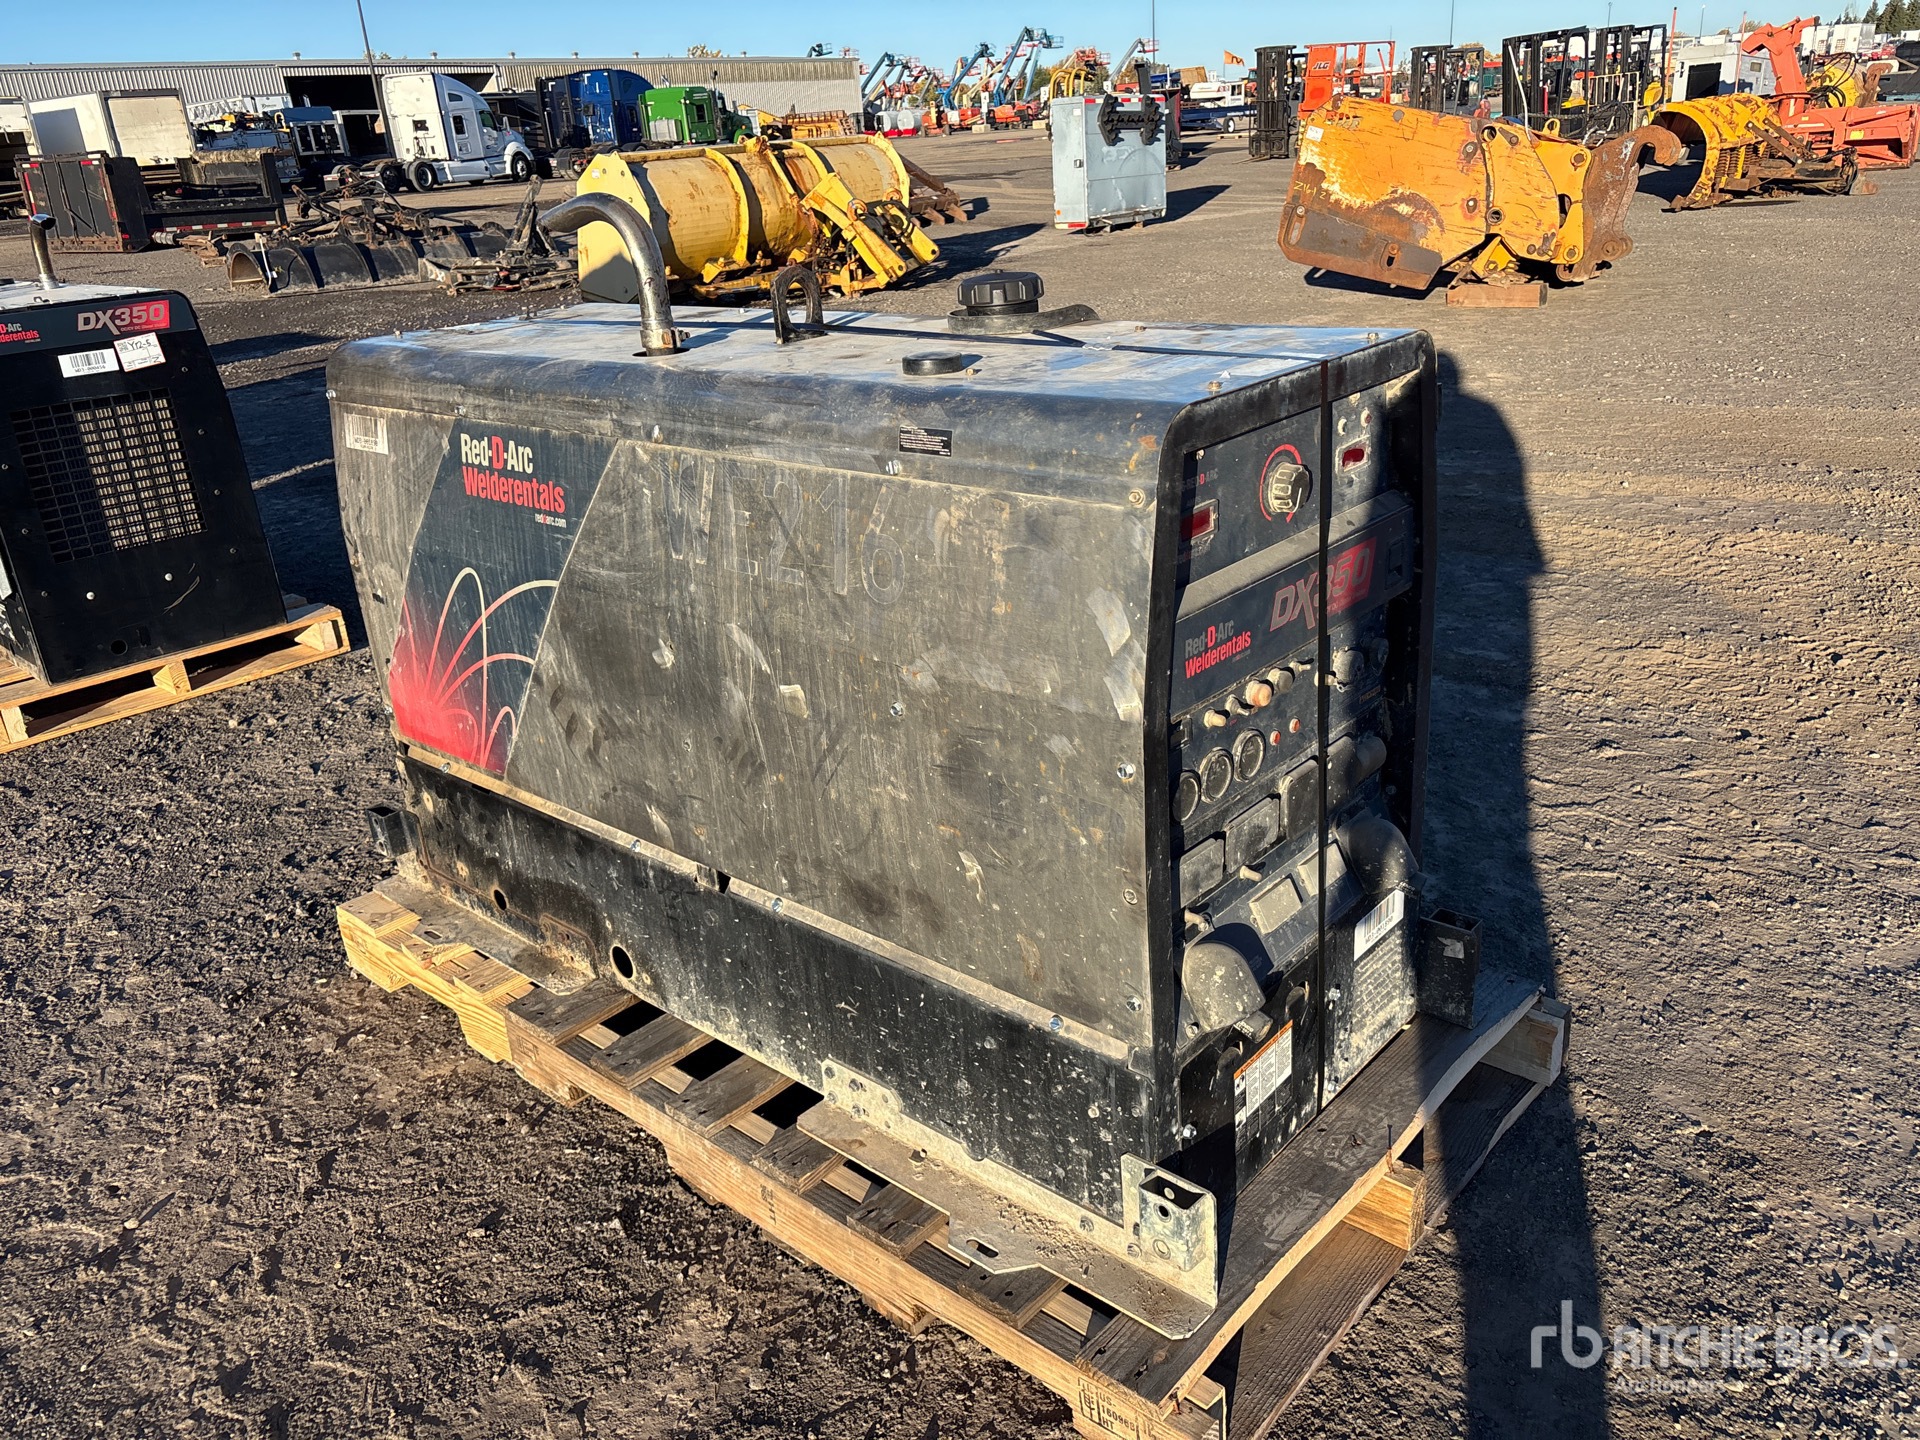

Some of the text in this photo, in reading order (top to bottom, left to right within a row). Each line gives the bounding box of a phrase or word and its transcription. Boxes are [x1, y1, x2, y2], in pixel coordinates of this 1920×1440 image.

[1312, 62, 1330, 70] JLG
[78, 304, 165, 336] DX350
[460, 433, 533, 474] Red-D-Arc
[462, 465, 566, 513] Welderentals
[535, 513, 567, 528] reddarc.com
[1269, 547, 1370, 632] DX350
[1185, 619, 1235, 659] Red-D-Arc
[1185, 630, 1252, 679] Welderentals
[1102, 1416, 1115, 1431] HT
